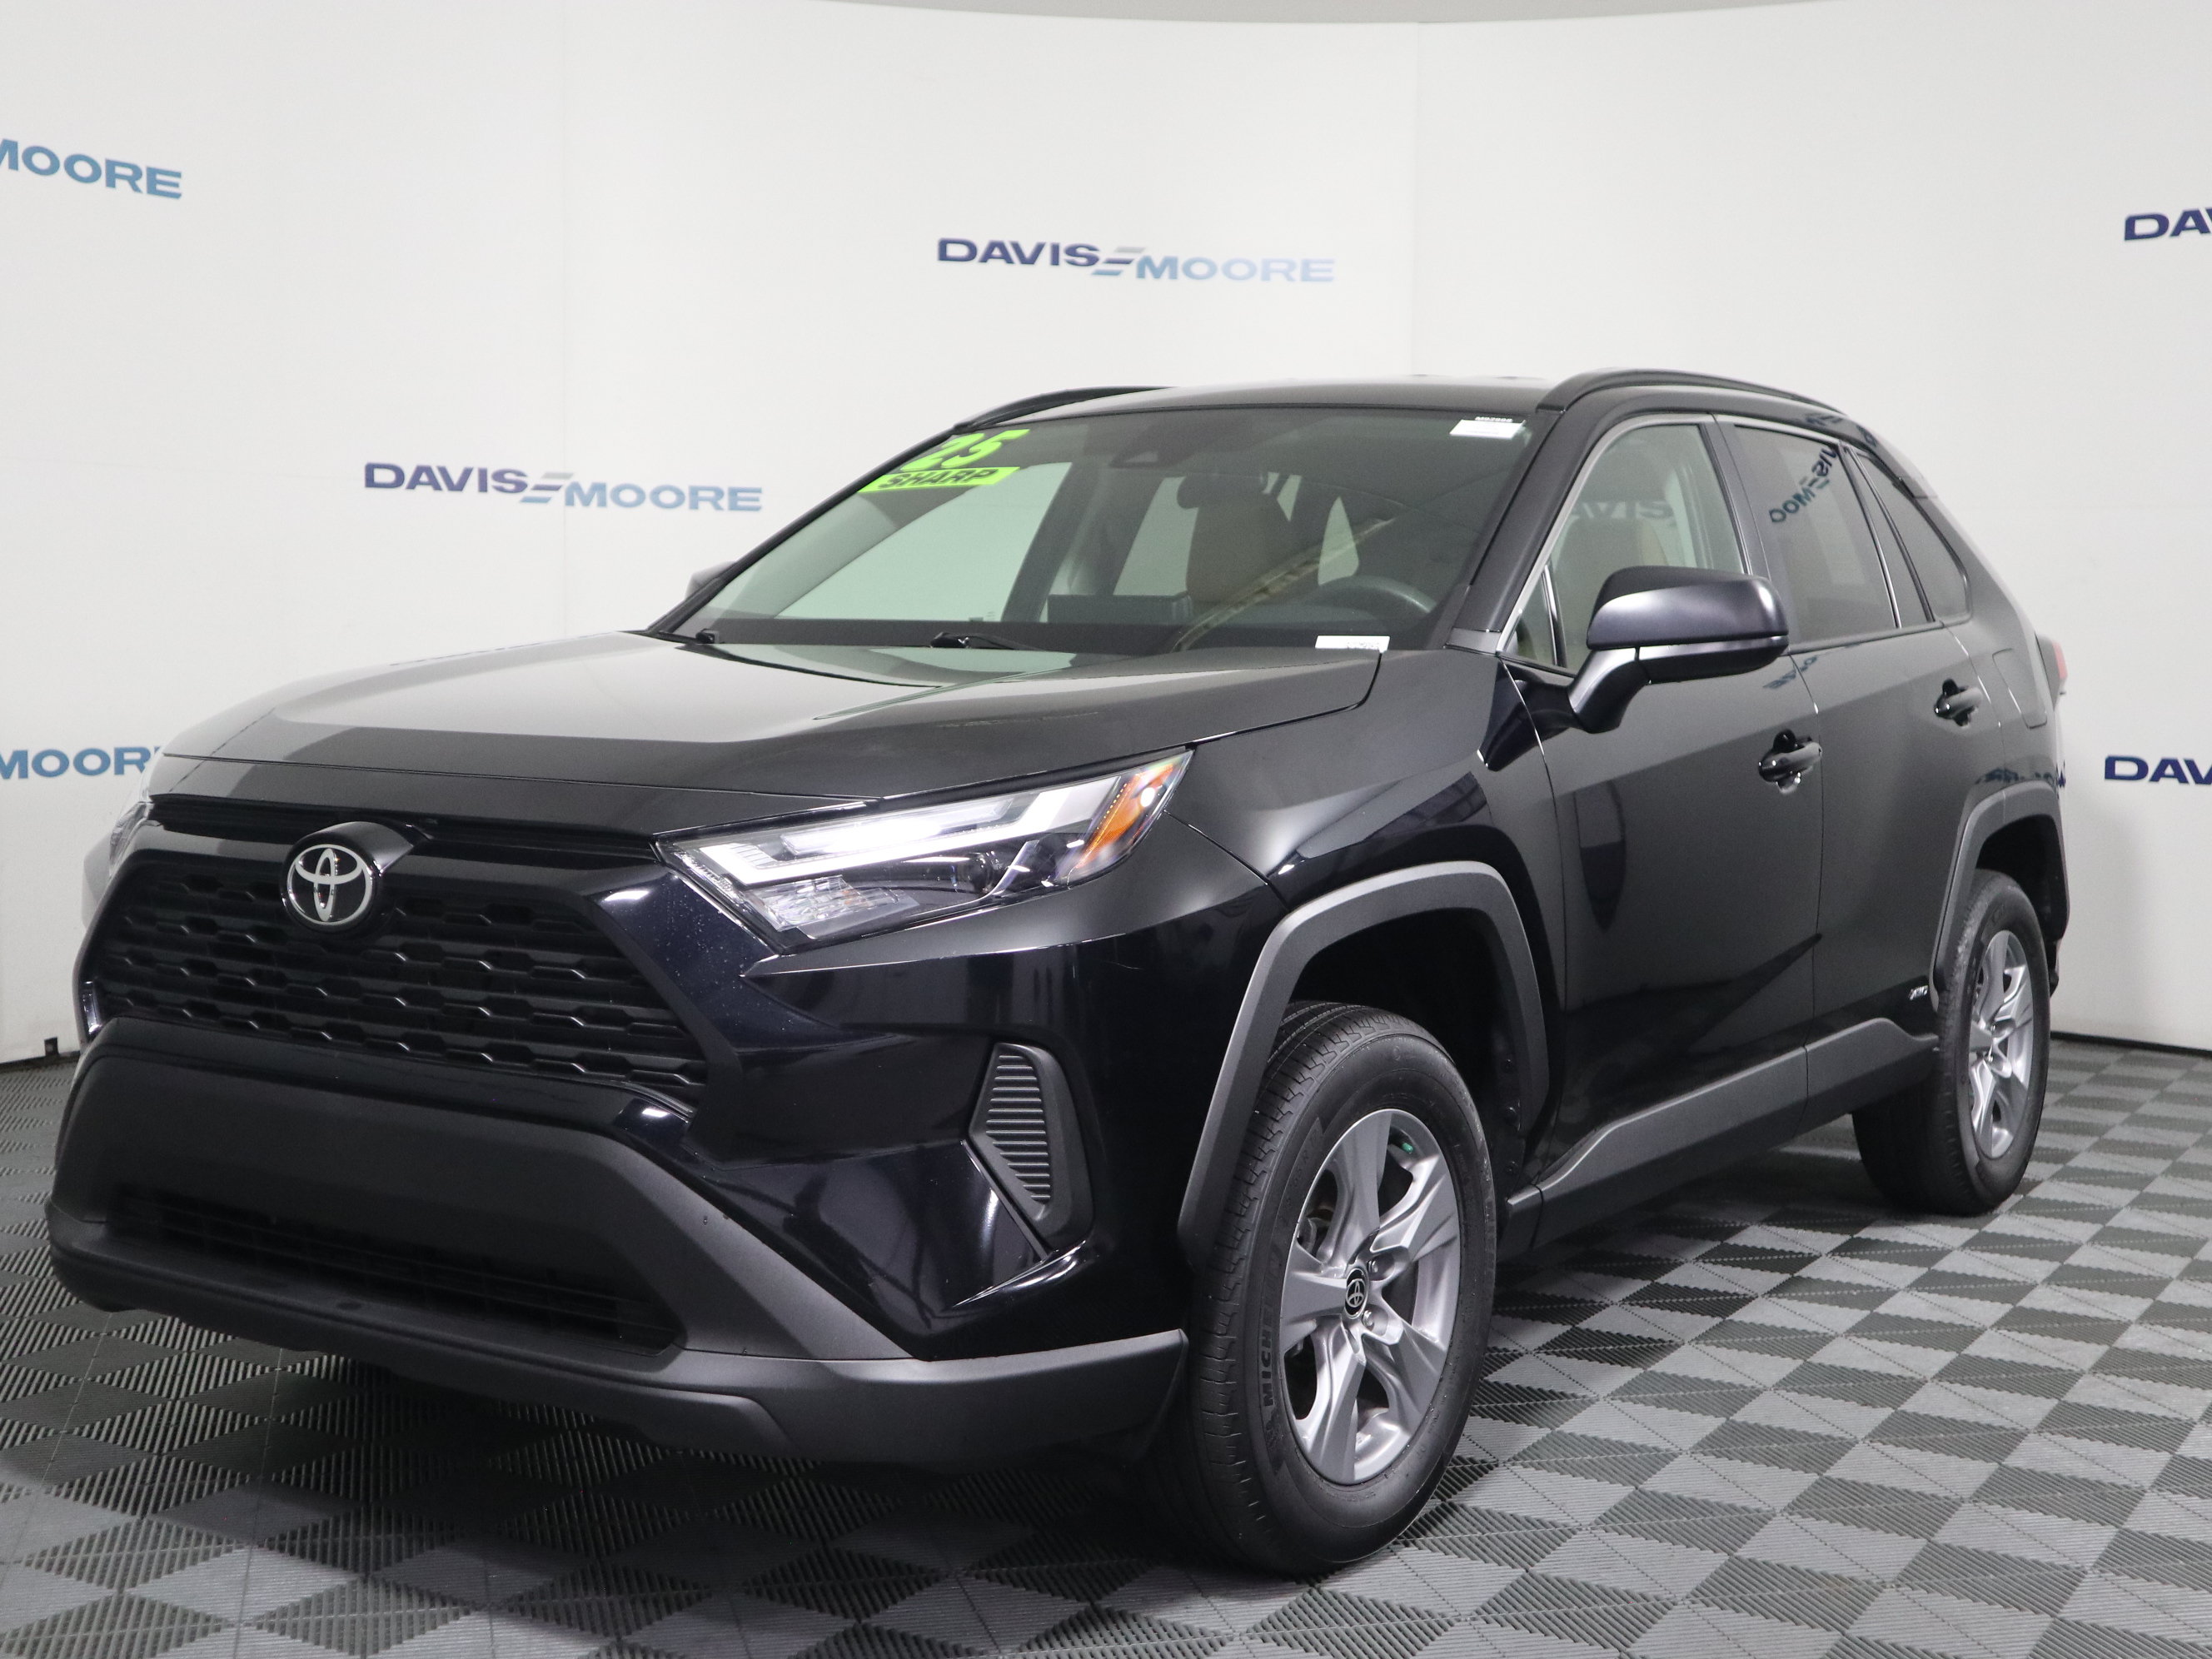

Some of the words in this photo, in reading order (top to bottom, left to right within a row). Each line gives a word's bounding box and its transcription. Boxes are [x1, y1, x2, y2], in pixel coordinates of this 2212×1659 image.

[2124, 207, 2212, 241] DA
[938, 237, 1100, 267] DAVIS
[1136, 254, 1335, 282] MOORE
[900, 428, 1031, 472] 25
[364, 462, 529, 493] DAVIS
[564, 481, 763, 512] MOORE
[878, 468, 999, 489] SHARP
[0, 746, 162, 780] MOOR
